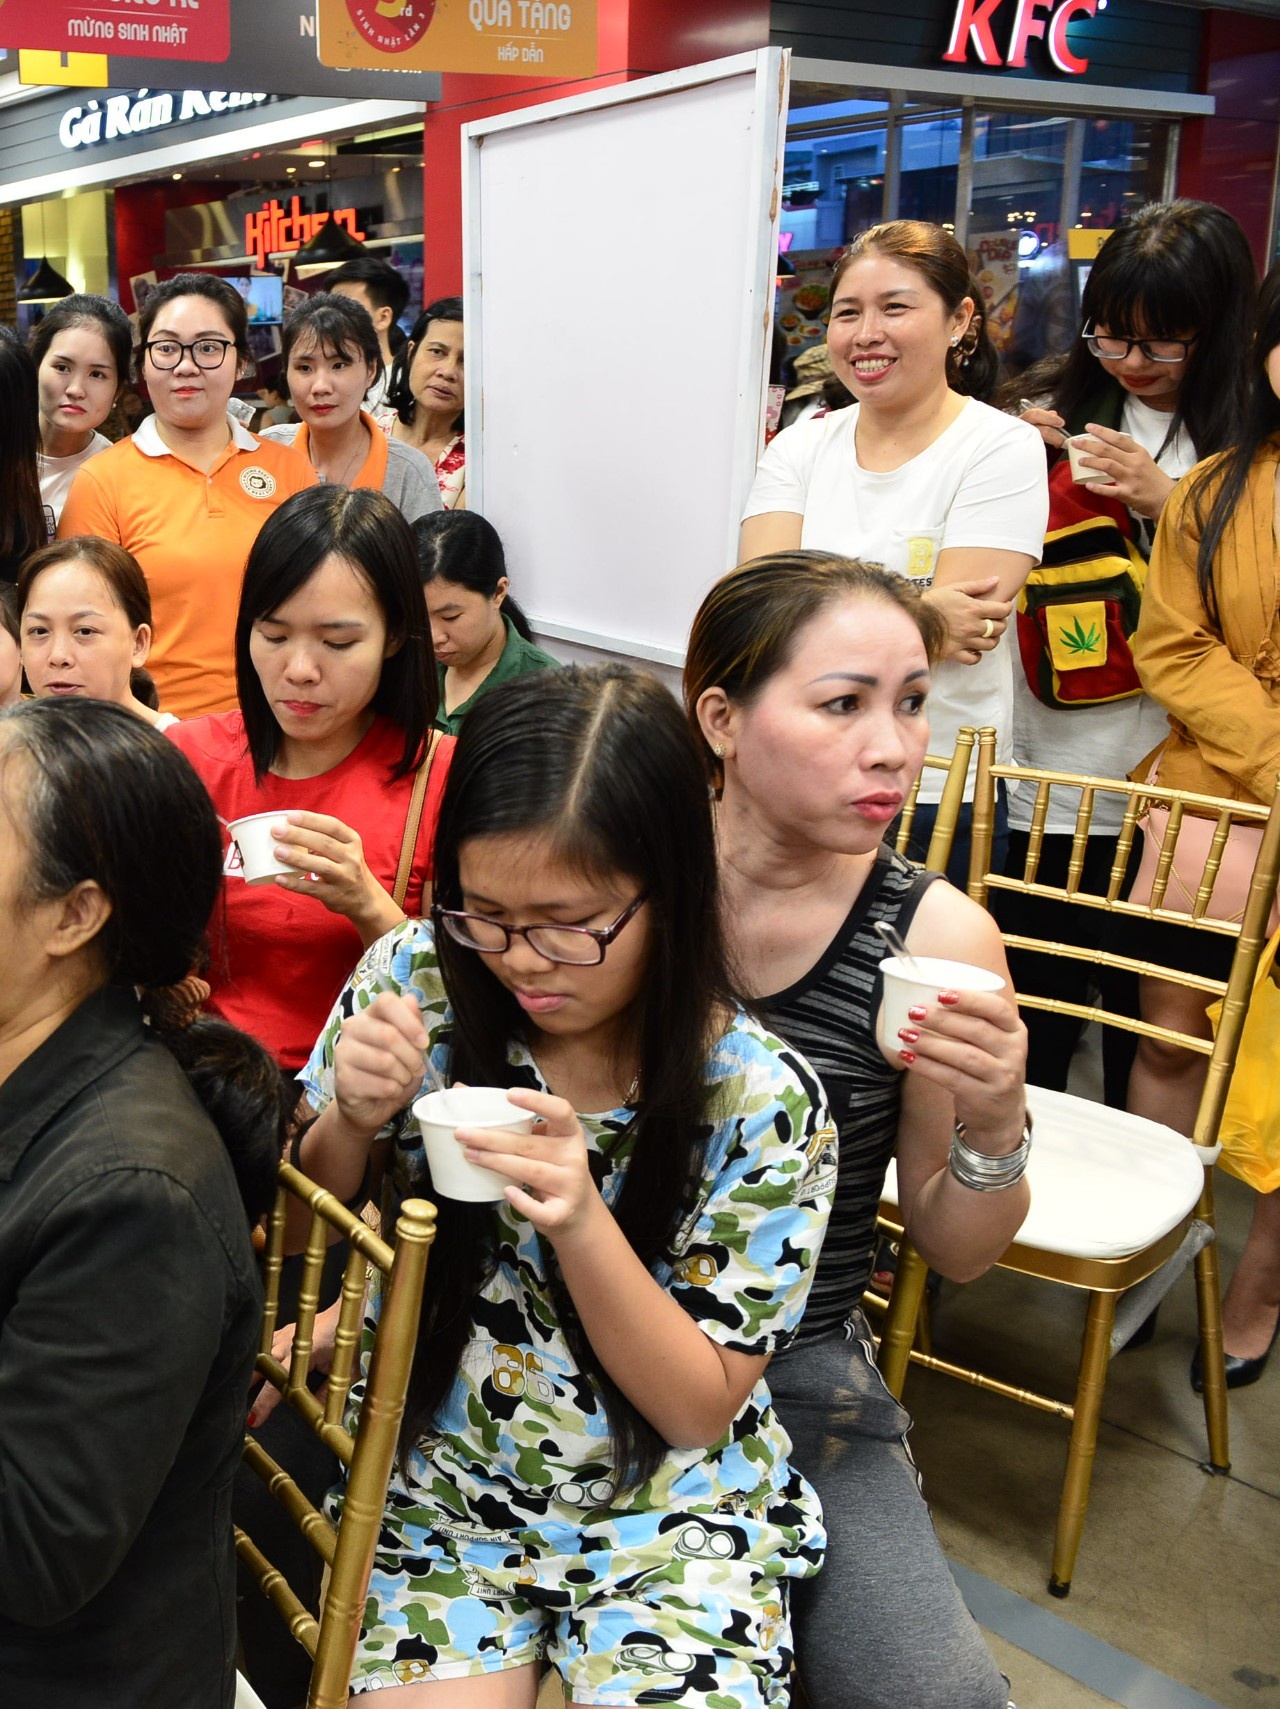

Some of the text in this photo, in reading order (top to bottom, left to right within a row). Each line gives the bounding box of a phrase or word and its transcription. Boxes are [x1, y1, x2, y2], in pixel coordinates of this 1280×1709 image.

[68, 15, 188, 47] MỪNG SINH NHẬT
[497, 41, 519, 61] HẤP
[942, 0, 1097, 74] KFC
[59, 100, 102, 149] Gà
[105, 88, 173, 139] Rán
